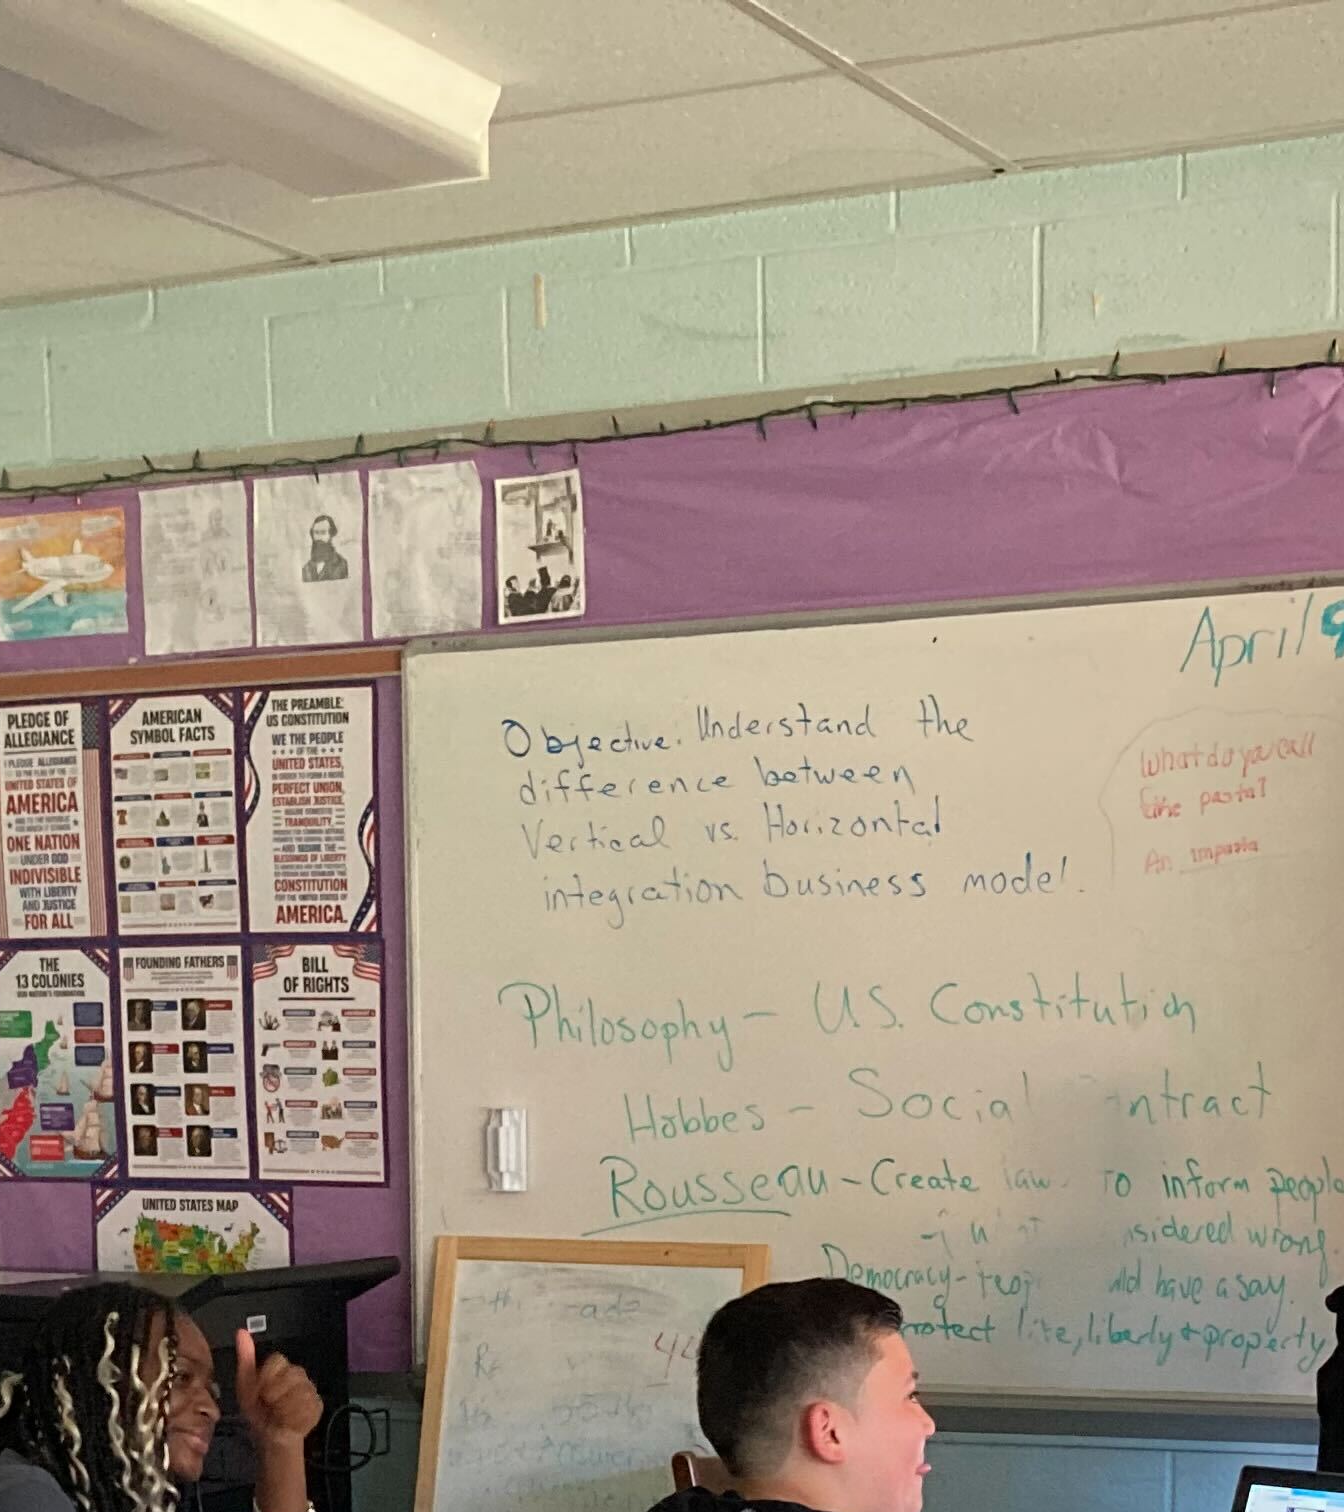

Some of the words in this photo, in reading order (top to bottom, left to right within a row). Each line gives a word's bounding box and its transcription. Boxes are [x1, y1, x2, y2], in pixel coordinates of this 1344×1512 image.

[1179, 592, 1314, 688] April
[271, 699, 288, 712] THE
[8, 711, 50, 730] PLEDGE
[54, 710, 69, 727] OF
[142, 708, 202, 726] AMERICAN
[266, 715, 279, 727] US
[281, 712, 349, 727] CONSTITUTION
[696, 702, 877, 742] Understand
[917, 694, 974, 742] the
[4, 729, 75, 749] ALLEGIANCE
[130, 728, 176, 745] SYMBOL
[179, 726, 215, 743] FACTS
[272, 734, 286, 746] WE
[289, 733, 306, 745] THE
[309, 731, 344, 744] PEOPLE
[272, 757, 305, 770] UNITED
[5, 779, 34, 791] UNITED
[36, 778, 65, 789] STATES
[67, 777, 77, 788] OF
[272, 782, 310, 795] PERFECT
[520, 769, 736, 805] difference
[753, 755, 916, 796] between
[6, 791, 79, 815] AMERICA
[272, 796, 311, 807] ESTABLISH
[521, 815, 672, 860] Vertical
[705, 822, 739, 842] vs.
[762, 795, 942, 843] Horizontal
[7, 835, 32, 852] ONE
[35, 833, 80, 850] NATION
[20, 854, 49, 865] UNDER
[9, 867, 81, 885] INDIVISIBLE
[19, 887, 41, 898] WITH
[44, 886, 77, 898] LIBERTY
[274, 879, 348, 892] CONSTITUTION
[543, 865, 743, 930] integration
[762, 859, 928, 898] business
[962, 850, 1085, 897] model.
[23, 900, 40, 911] AND
[42, 899, 76, 911] JUSTICE
[25, 914, 47, 930] FOR
[52, 913, 74, 929] ALL
[276, 905, 348, 924] AMERICA.
[39, 957, 59, 972] THE
[136, 956, 181, 969] FOUNDING
[184, 955, 225, 968] FATHERS
[302, 956, 328, 973] BILL
[16, 974, 29, 988] 13
[31, 973, 85, 989] COLONIES
[283, 977, 299, 993] OF
[303, 976, 349, 993] RIGHTS
[498, 982, 733, 1072] Philosophy
[813, 981, 905, 1035] U.S.
[929, 971, 1197, 1034] Constitution
[623, 1093, 766, 1143] Hobbes
[848, 1066, 1031, 1124] Social
[1080, 1061, 1272, 1125] ntract
[599, 1154, 829, 1219] Rousseau
[871, 1157, 980, 1196] Create
[1162, 1158, 1251, 1200] inform
[142, 1198, 176, 1211] UNITED
[179, 1199, 213, 1211] STATES
[216, 1200, 239, 1212] MAP
[1156, 1264, 1204, 1305] have
[1216, 1276, 1230, 1299] a
